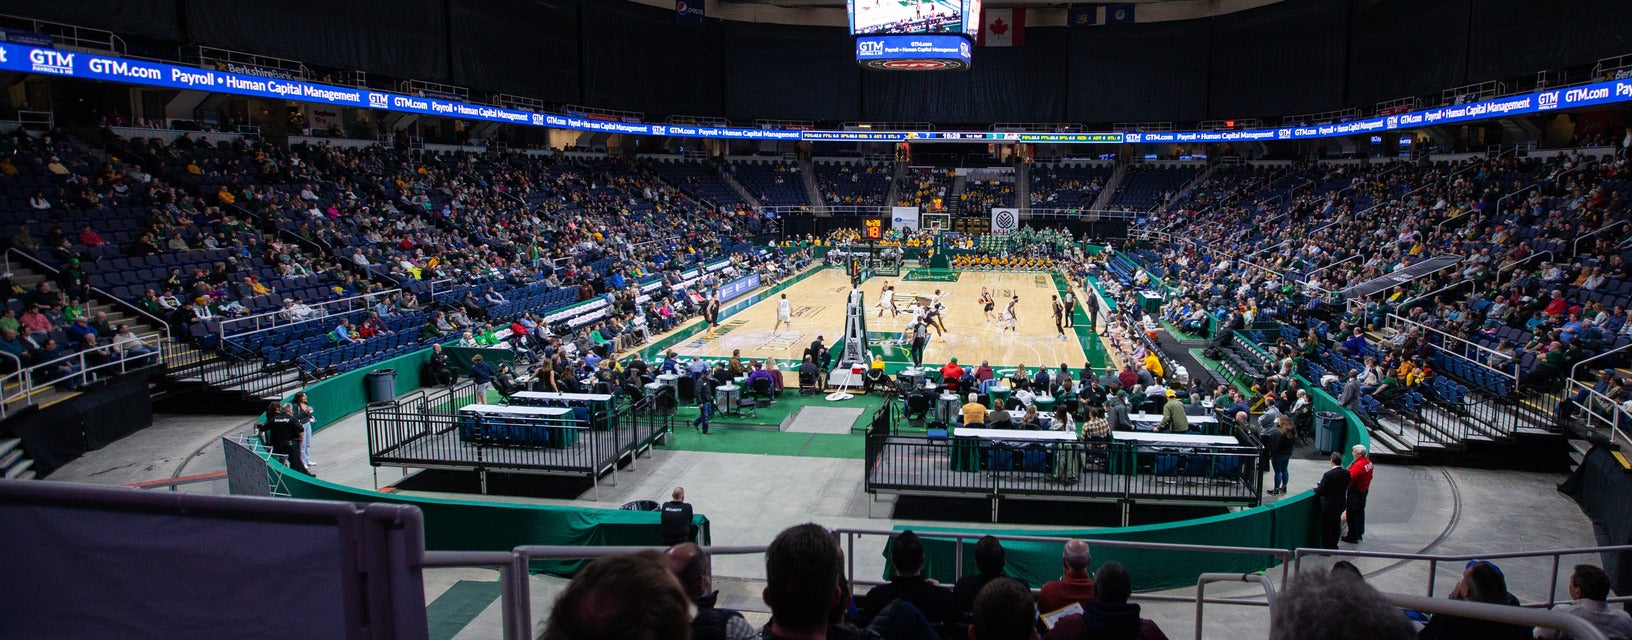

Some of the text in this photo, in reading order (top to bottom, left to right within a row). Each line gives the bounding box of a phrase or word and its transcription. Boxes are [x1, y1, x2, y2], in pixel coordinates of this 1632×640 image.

[860, 41, 884, 51] GTM
[30, 49, 74, 67] GTM
[89, 58, 360, 101] GTM.com Payroll Human Capital Management
[227, 63, 294, 80] BerkshireBank
[368, 93, 388, 104] GTM
[1538, 92, 1559, 105] GTM
[1565, 87, 1608, 102] GTM.com
[394, 97, 427, 109] GTM.com
[432, 101, 453, 113] Payroll
[458, 105, 478, 116] Human
[479, 108, 497, 118] Capital
[498, 110, 528, 122] Management
[1401, 115, 1422, 124] GTM.com
[1425, 110, 1441, 122] Payroll
[1445, 107, 1465, 118] Human
[1465, 103, 1486, 116] Capital
[1486, 97, 1530, 113] Management
[547, 116, 647, 133] GTM.com Payroll Human Capital Management
[1295, 128, 1316, 136] GTM.com
[1318, 126, 1333, 135] Payroll
[1348, 122, 1361, 132] Capital
[1361, 119, 1383, 130] Management
[1387, 116, 1398, 124] GTM
[670, 127, 696, 135] GTM.com
[698, 128, 718, 136] Payroll
[743, 130, 762, 138] Capital
[763, 131, 799, 139] Management
[1177, 134, 1197, 142] Payroll
[1221, 132, 1240, 140] Capital
[1240, 131, 1273, 139] Management
